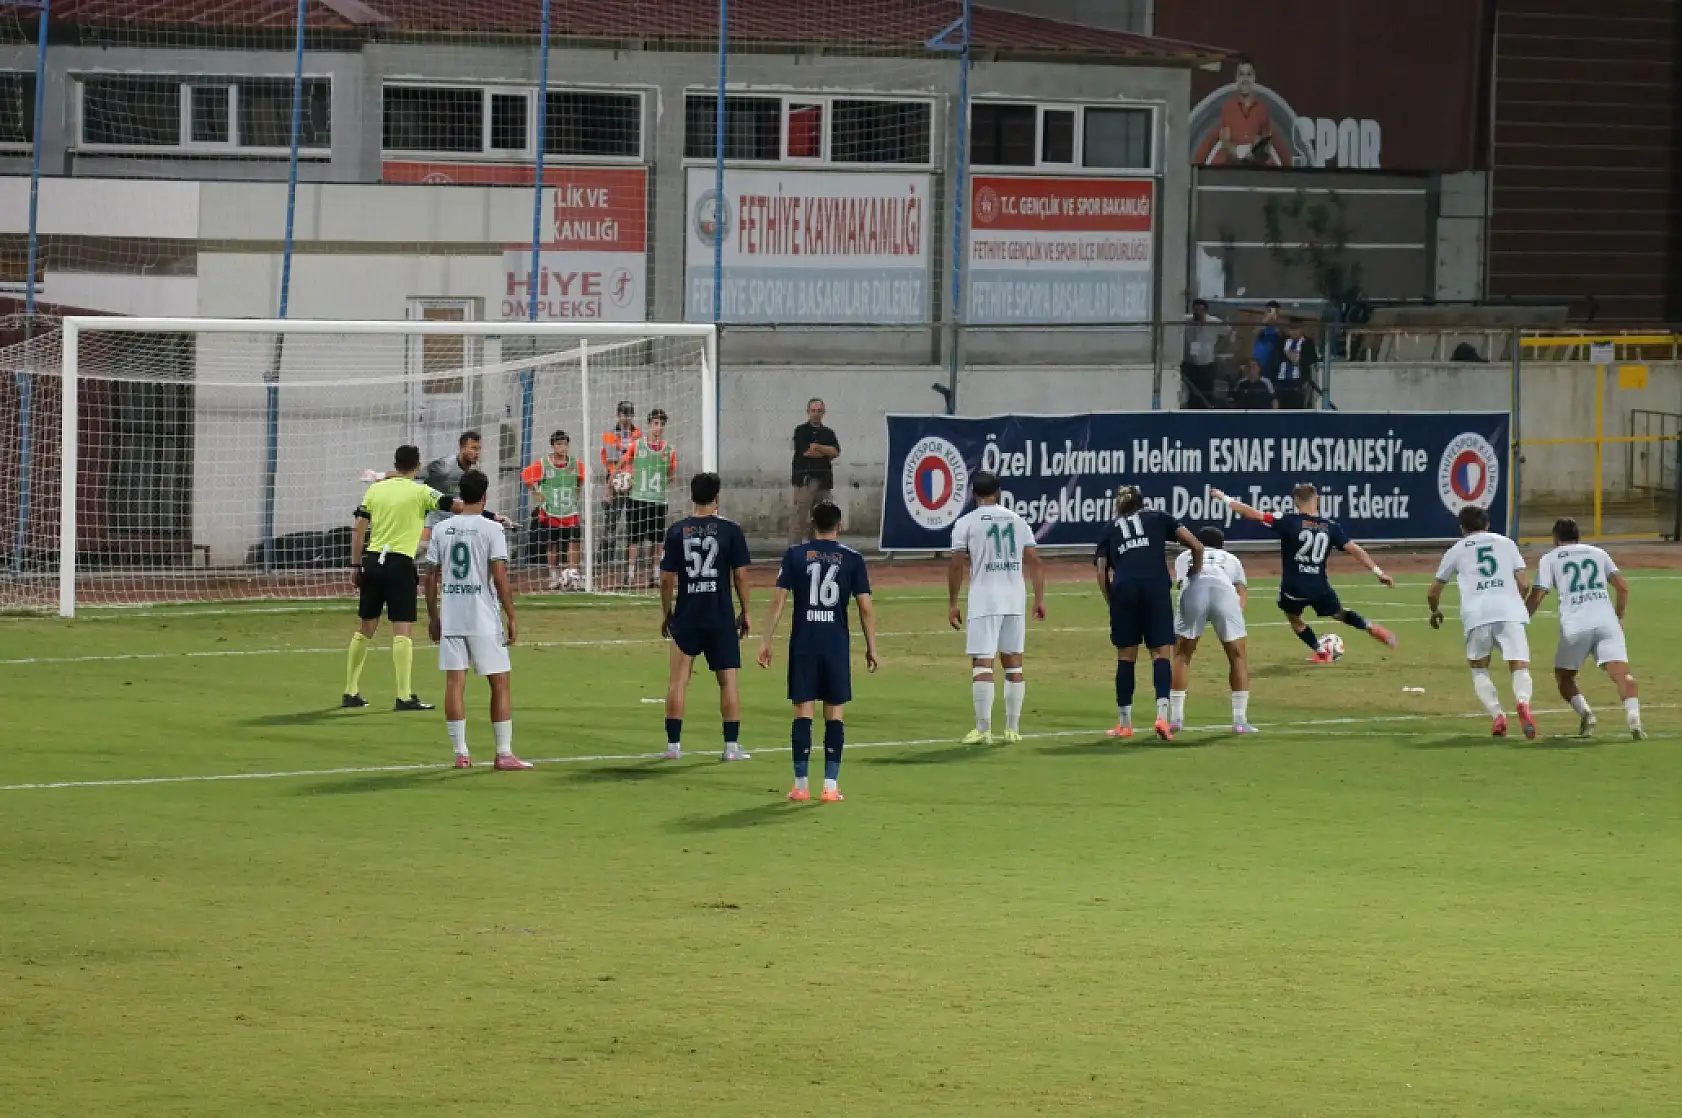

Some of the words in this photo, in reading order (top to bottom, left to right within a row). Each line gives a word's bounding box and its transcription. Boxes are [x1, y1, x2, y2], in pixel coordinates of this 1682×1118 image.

[587, 188, 609, 208] VE
[1002, 196, 1018, 215] T.C.
[1020, 194, 1060, 220] GENÇLİK
[1062, 196, 1075, 216] VE
[1077, 197, 1101, 216] SPOR
[738, 182, 800, 254] FETHİYE
[804, 184, 922, 256] KAYMAKAMLIĞI
[982, 432, 1033, 477] Özel
[1040, 439, 1125, 477] Lokman
[1132, 436, 1202, 474] Hekim
[1208, 437, 1275, 472] ESNAF
[639, 469, 662, 493] 14
[1348, 484, 1410, 519] Ederiz
[985, 522, 1017, 559] 11
[1115, 513, 1145, 539] 11
[450, 541, 471, 580] 9
[683, 536, 719, 578] 52
[1294, 529, 1329, 563] 20
[1475, 545, 1498, 577] 5
[806, 562, 840, 607] 16
[1562, 558, 1604, 593] 22
[806, 610, 835, 622] ONUR
